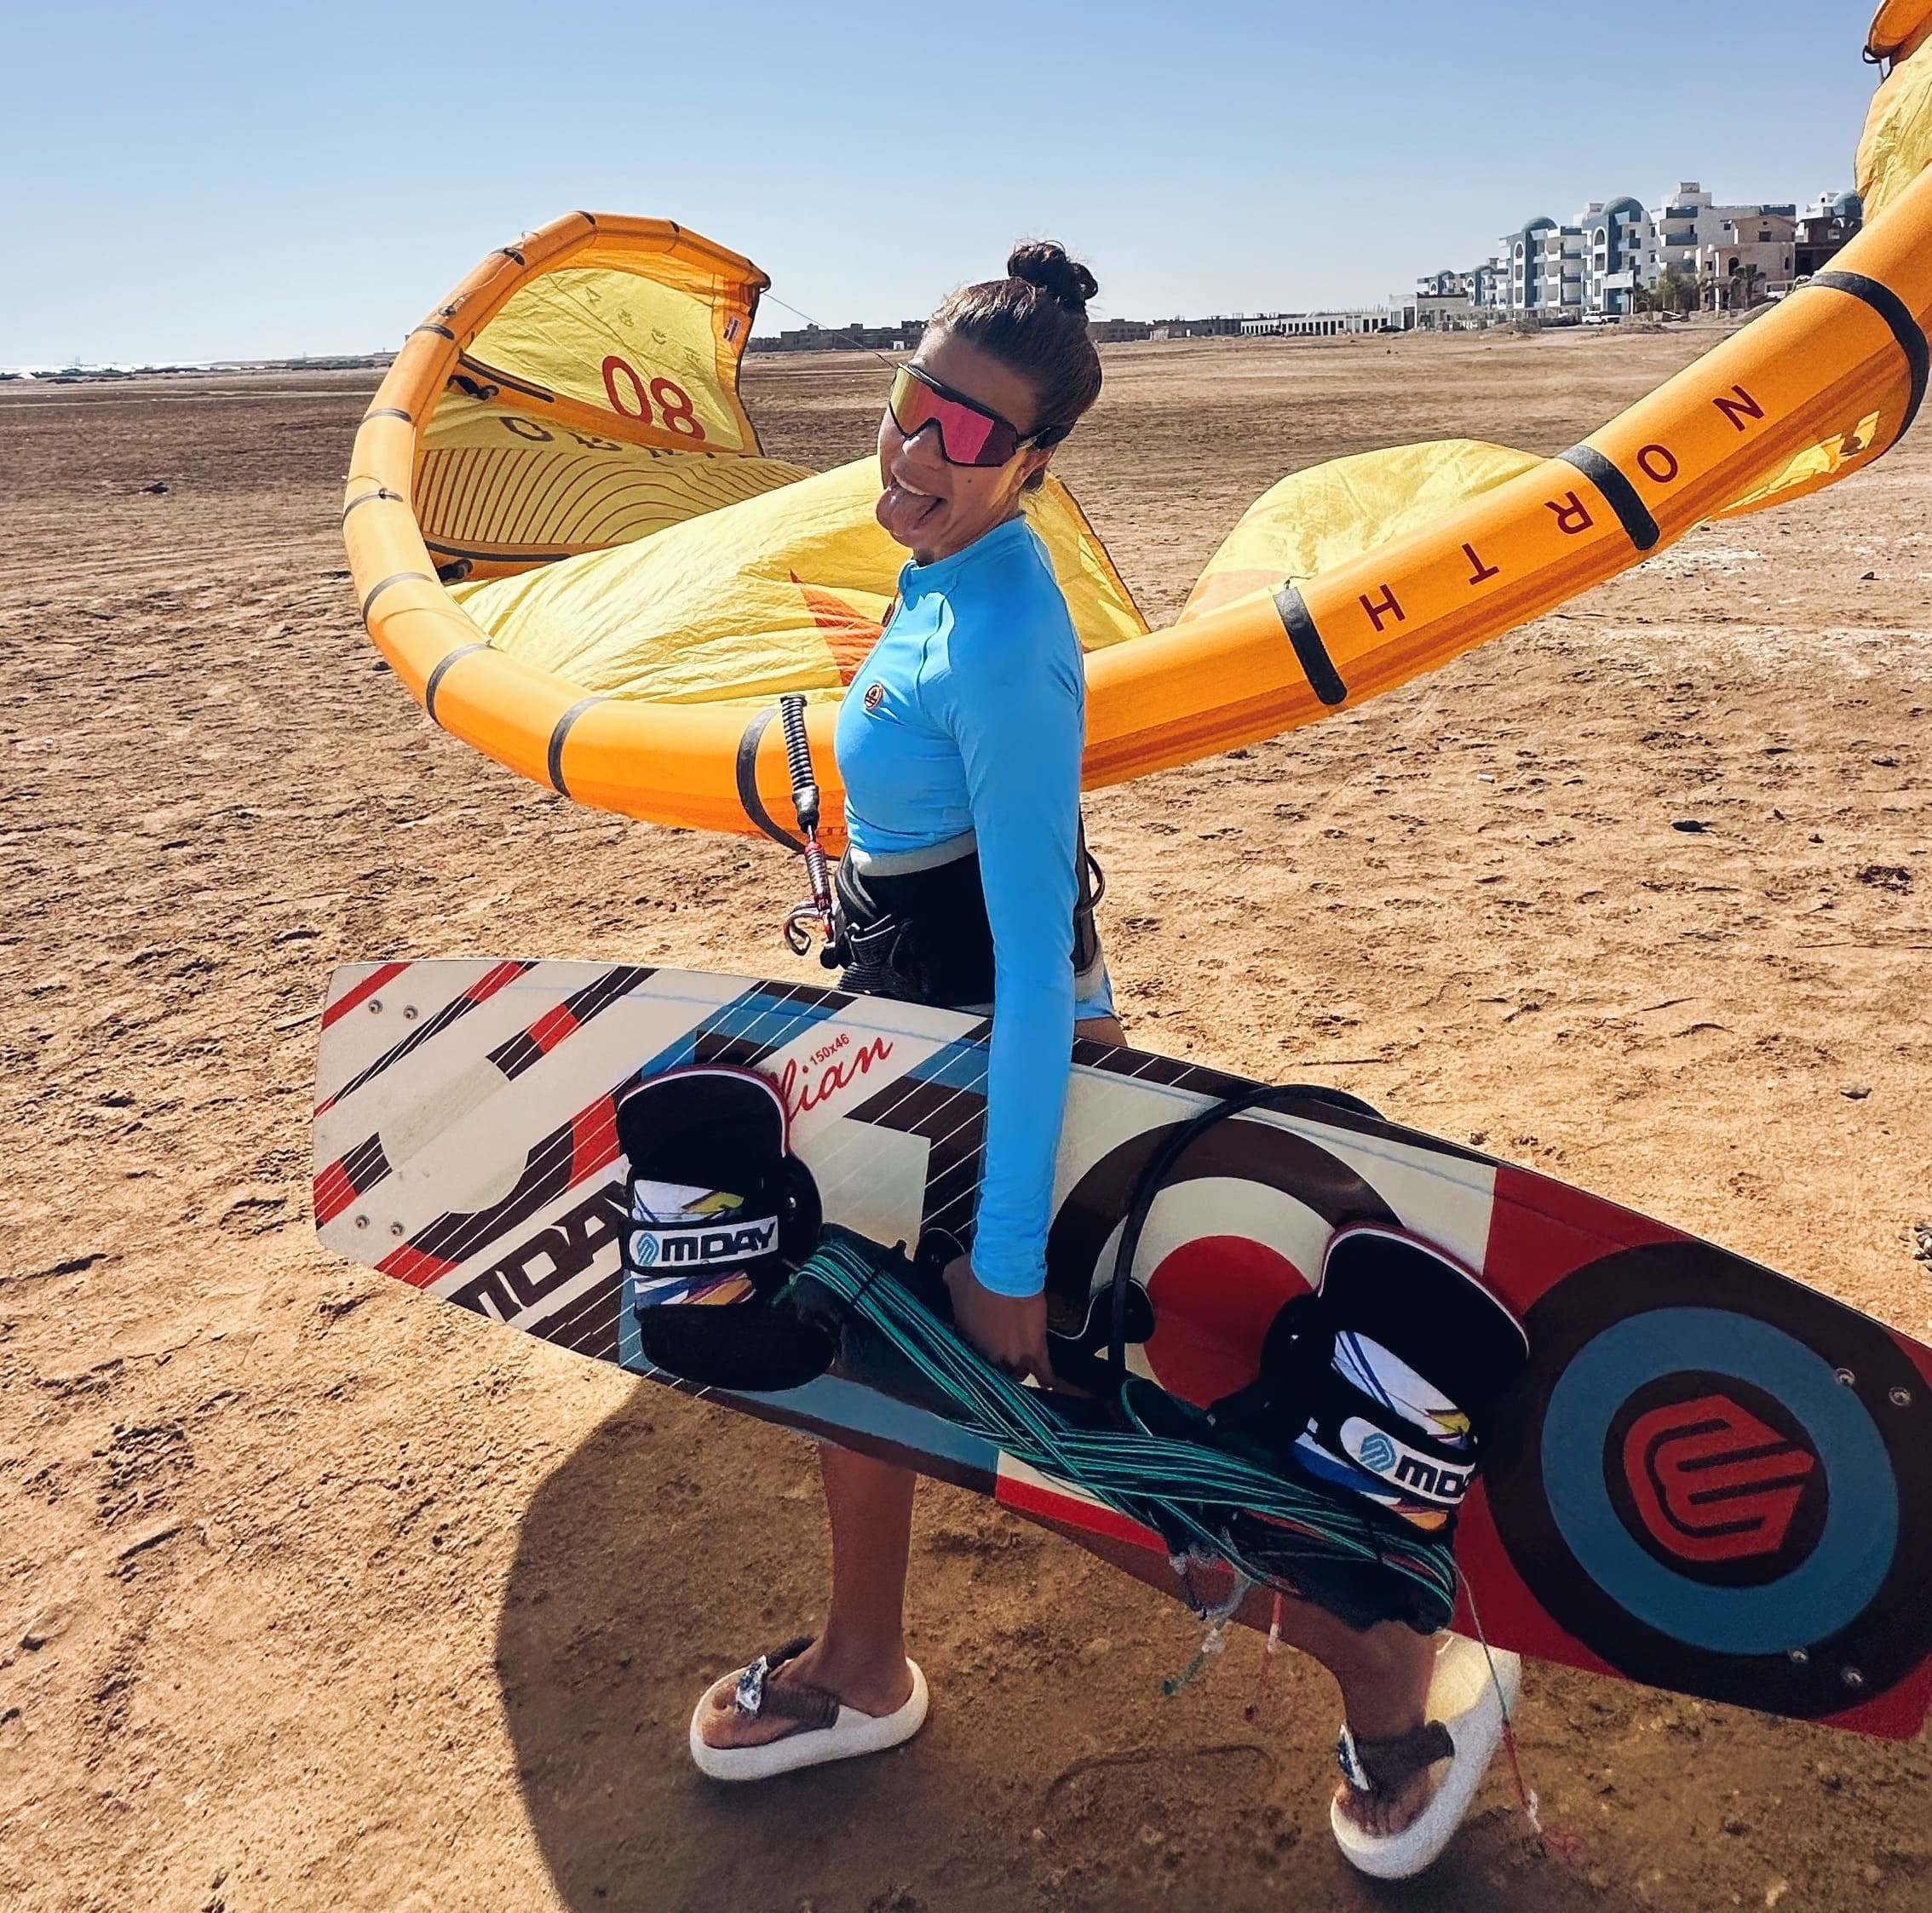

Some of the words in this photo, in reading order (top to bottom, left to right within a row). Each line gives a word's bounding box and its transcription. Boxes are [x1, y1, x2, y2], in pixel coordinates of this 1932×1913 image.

[601, 355, 705, 441] 08
[1358, 384, 1765, 632] NORTH
[772, 1037, 894, 1123] lian
[810, 1033, 850, 1065] 150x46
[1394, 1455, 1469, 1498] MD
